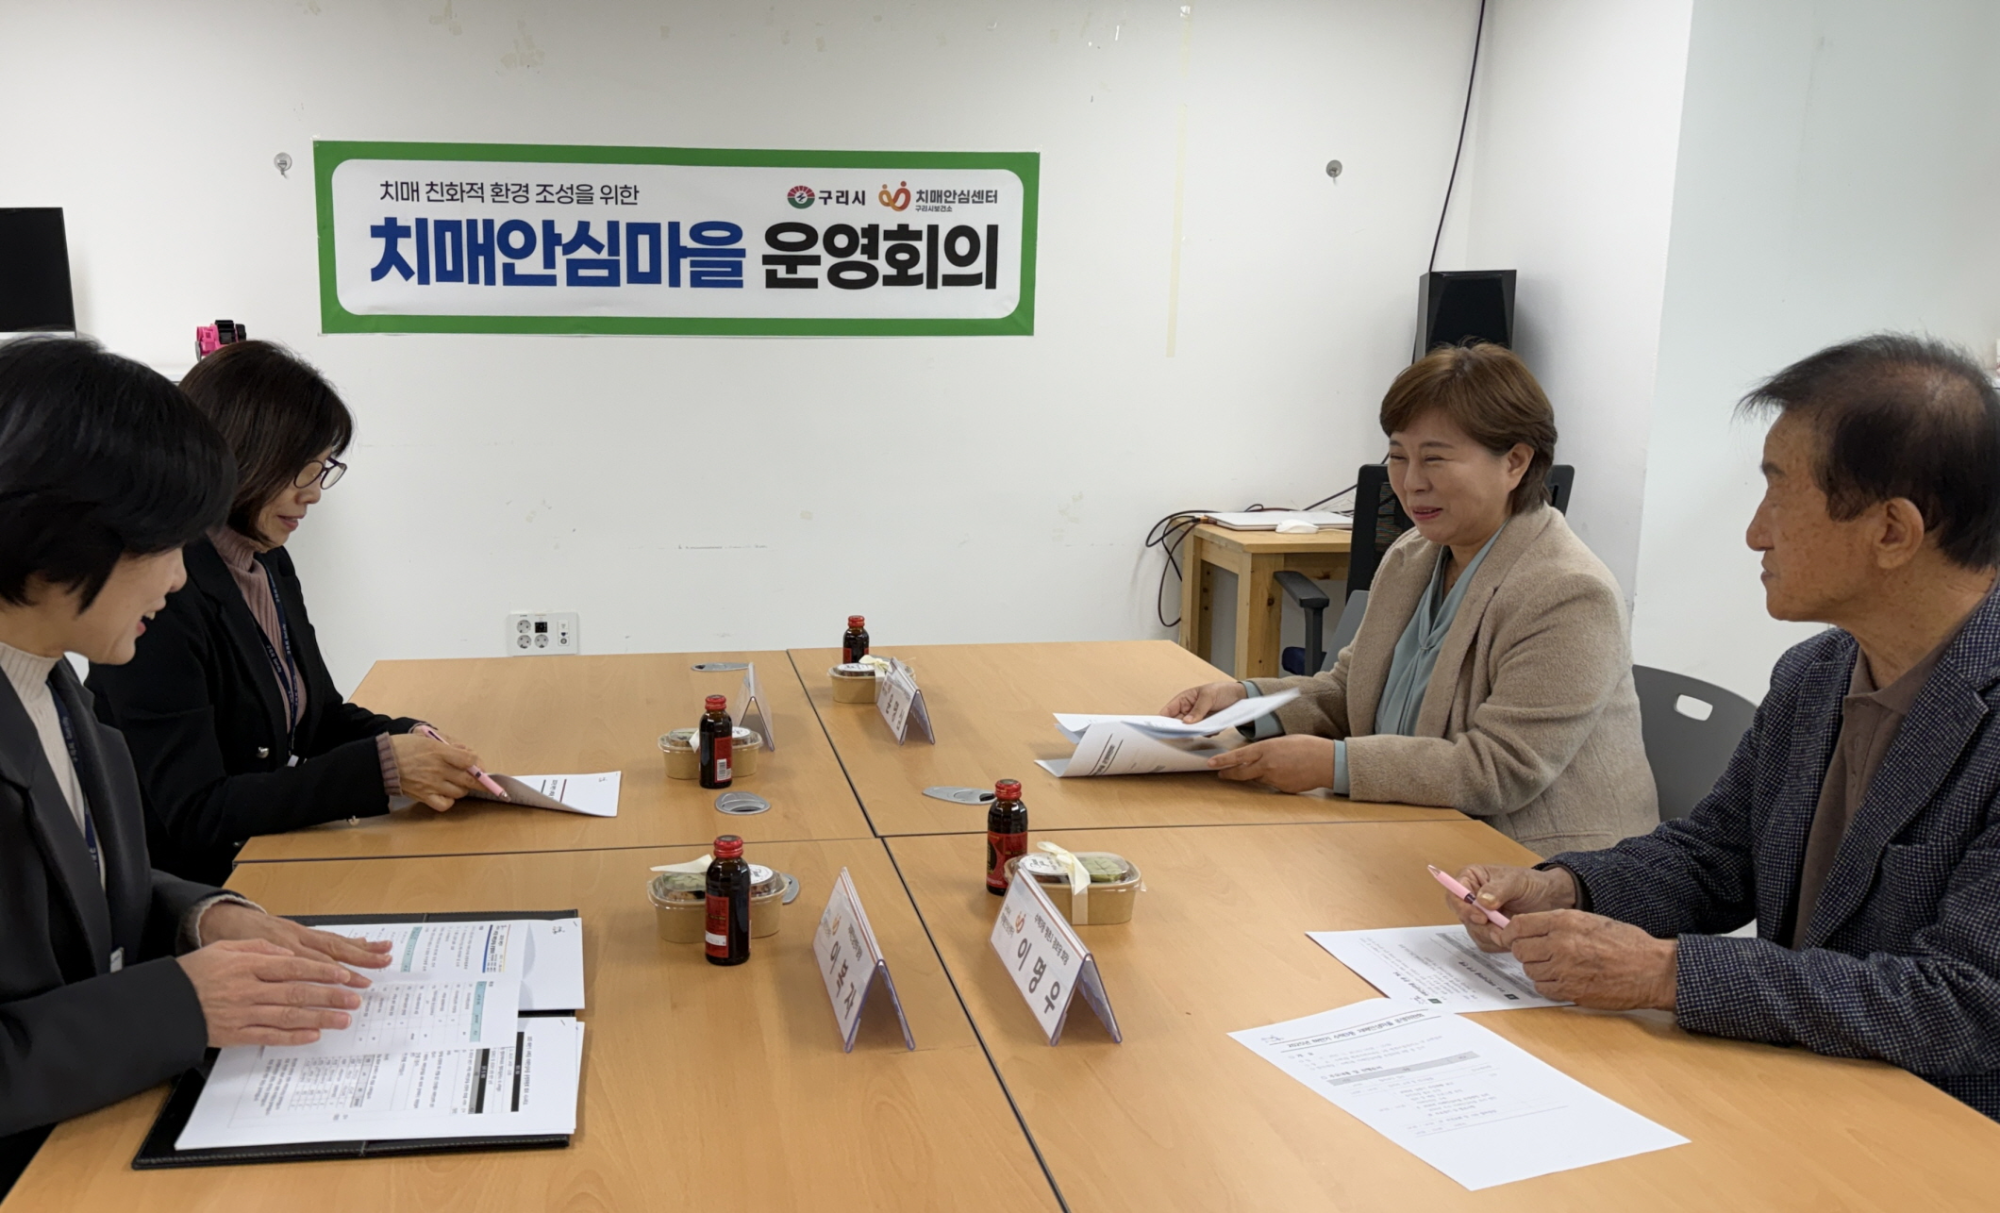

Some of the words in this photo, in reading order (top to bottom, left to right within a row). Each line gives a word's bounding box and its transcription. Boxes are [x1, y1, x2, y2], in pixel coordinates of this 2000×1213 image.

[379, 180, 420, 203] 치매
[425, 181, 486, 204] 친화적
[490, 182, 530, 204] 환경
[535, 183, 595, 205] 조성을
[599, 184, 640, 206] 위한
[818, 189, 867, 206] 구리시
[914, 189, 999, 205] 치매안심센터
[914, 204, 953, 213] 구리시보건소
[370, 216, 747, 289] 치매안심마을
[762, 221, 1000, 291] 운영회의
